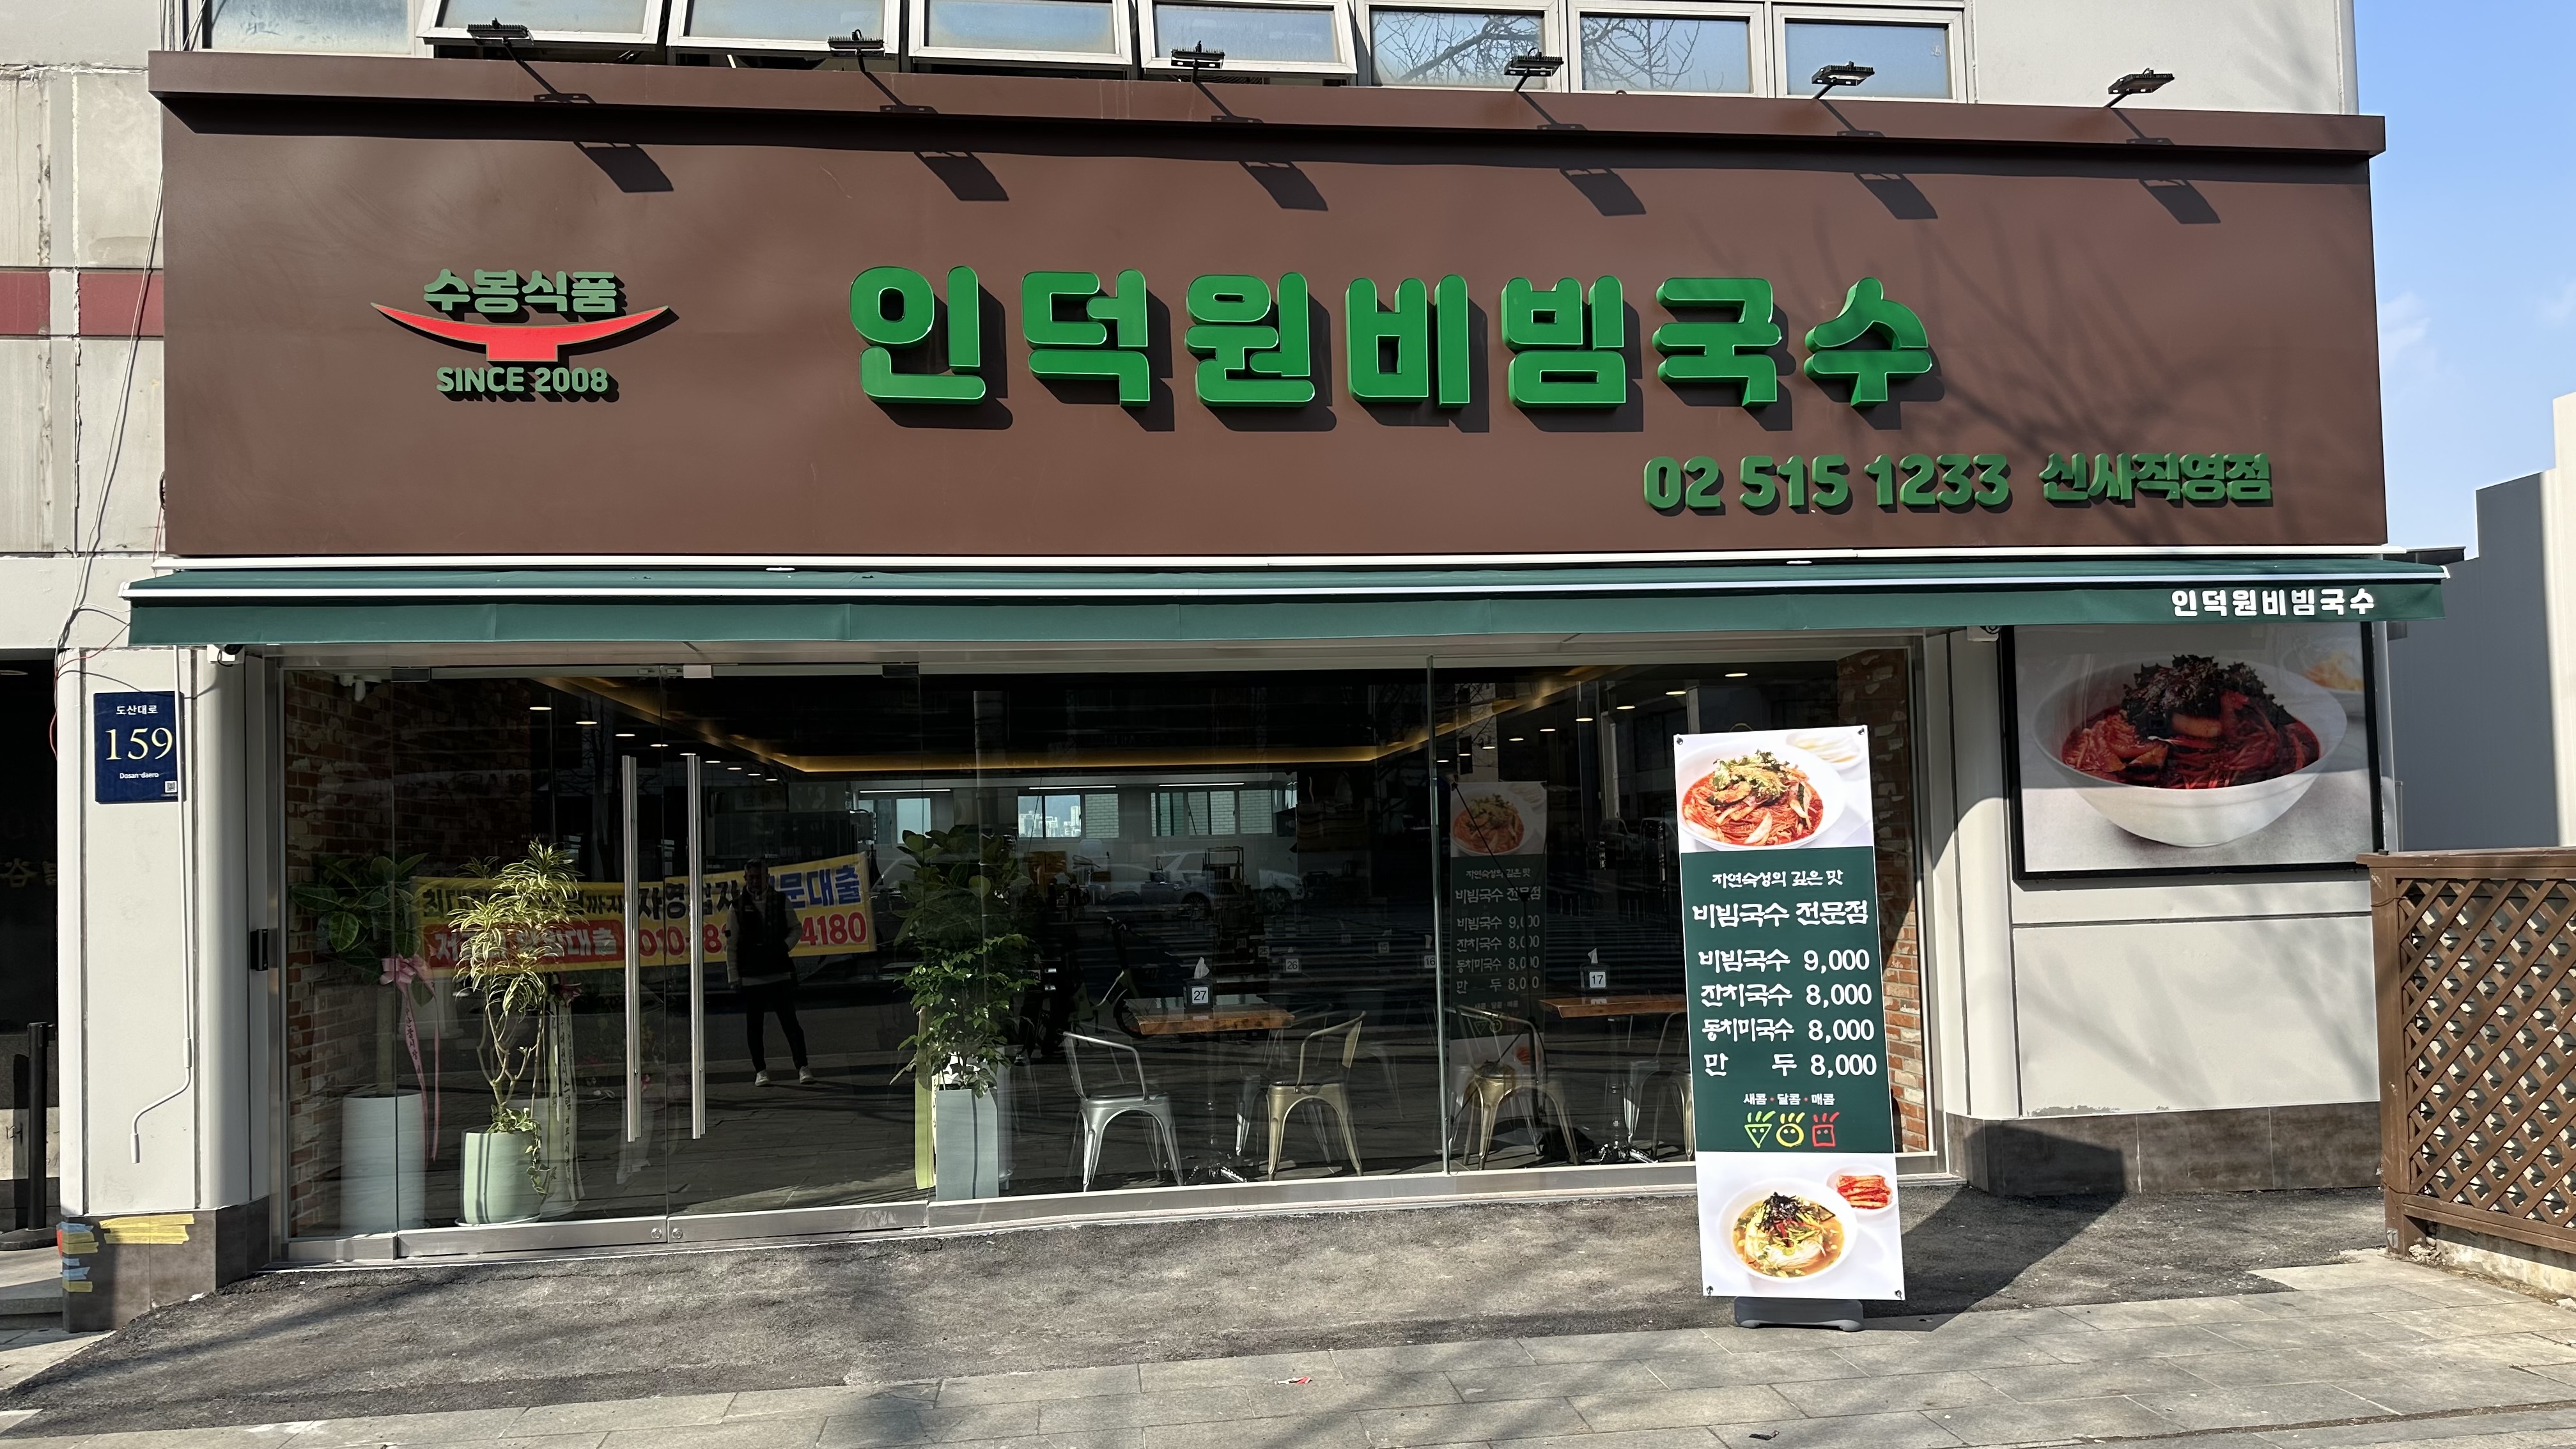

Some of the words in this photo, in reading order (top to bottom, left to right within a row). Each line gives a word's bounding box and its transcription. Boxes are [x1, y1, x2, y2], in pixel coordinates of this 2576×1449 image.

[423, 268, 617, 313] 수봉식품
[850, 266, 1933, 407] 인덕원비빔국수
[437, 367, 524, 392] SINCE
[535, 367, 609, 392] 2008
[1643, 454, 1721, 509] 02
[1739, 453, 1849, 508] 515
[1865, 453, 2010, 506] 1233
[2039, 451, 2272, 502] 신사직영점
[2171, 587, 2375, 617] 인덕원비빔국수
[116, 704, 159, 715] 도산대로
[105, 727, 173, 761] 159
[769, 865, 861, 909] 문대출
[1712, 871, 1787, 888] 자연숙성의
[1790, 870, 1823, 887] 깊은
[1826, 869, 1843, 886] 맛
[1455, 888, 1503, 904] 비빔국수
[1457, 916, 1502, 931] 비빔국수
[1692, 903, 1790, 929] 비빔국수
[1796, 899, 1869, 926] 전문점
[1457, 936, 1502, 952] 잔치국수
[1287, 961, 1298, 970] 26
[1426, 957, 1436, 966] 16
[1456, 957, 1501, 973] 동치미국수
[1509, 956, 1539, 971] 8,00
[1698, 949, 1790, 973] 비빔국수
[1803, 949, 1870, 974] 9,000
[1508, 976, 1539, 991] 8,00
[1592, 975, 1604, 985] 17
[1193, 990, 1207, 1001] 27
[1700, 983, 1793, 1007] 잔치국수
[1806, 983, 1872, 1009] 8,000
[1702, 1018, 1795, 1042] 동치미국수
[1808, 1019, 1874, 1044] 8,000
[1810, 1054, 1877, 1079] 8,000
[1743, 1093, 1767, 1105] 새콤
[1777, 1093, 1801, 1105] 달콤
[1811, 1093, 1835, 1106] 매콤
